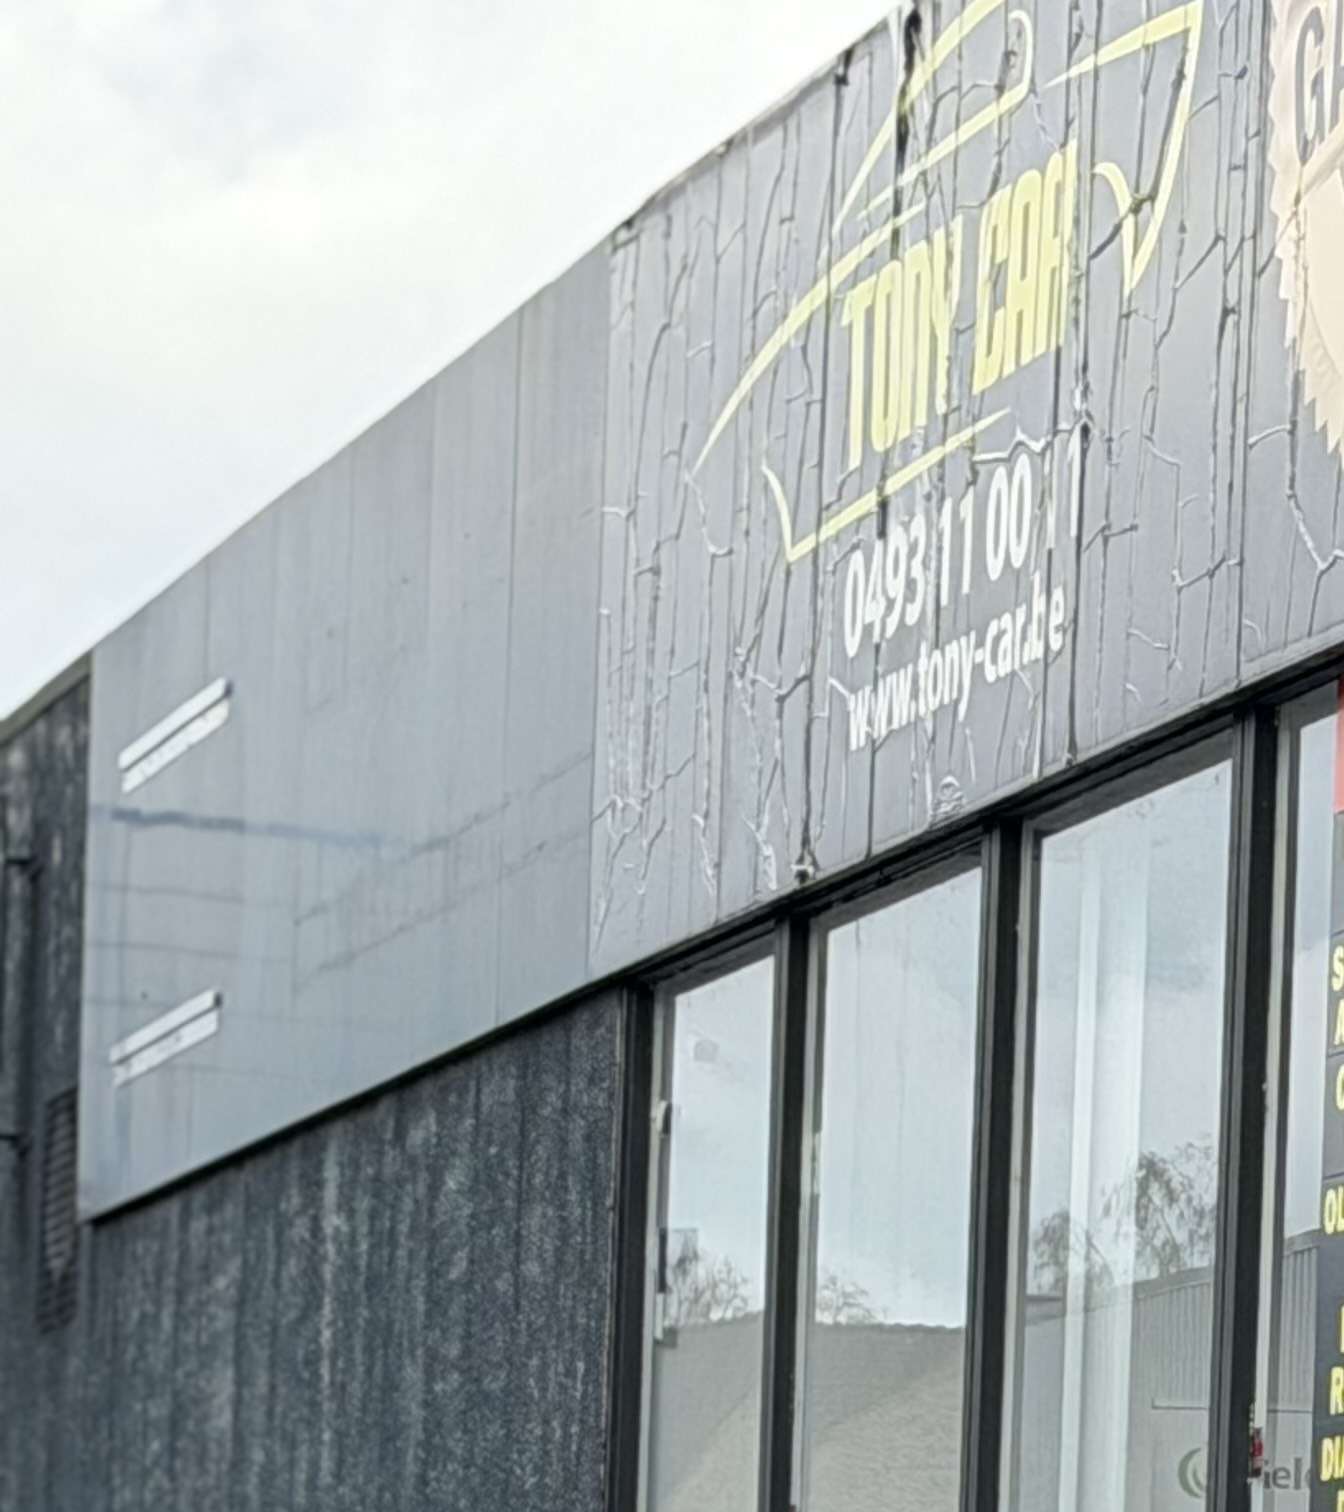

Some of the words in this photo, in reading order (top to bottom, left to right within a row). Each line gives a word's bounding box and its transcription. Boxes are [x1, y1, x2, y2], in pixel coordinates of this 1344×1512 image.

[841, 214, 963, 478] TONY
[972, 137, 1078, 396] CAR
[843, 514, 927, 660] 0493
[938, 486, 975, 608] 11
[985, 452, 1032, 582] 00
[847, 570, 1066, 751] www.tony-car.be
